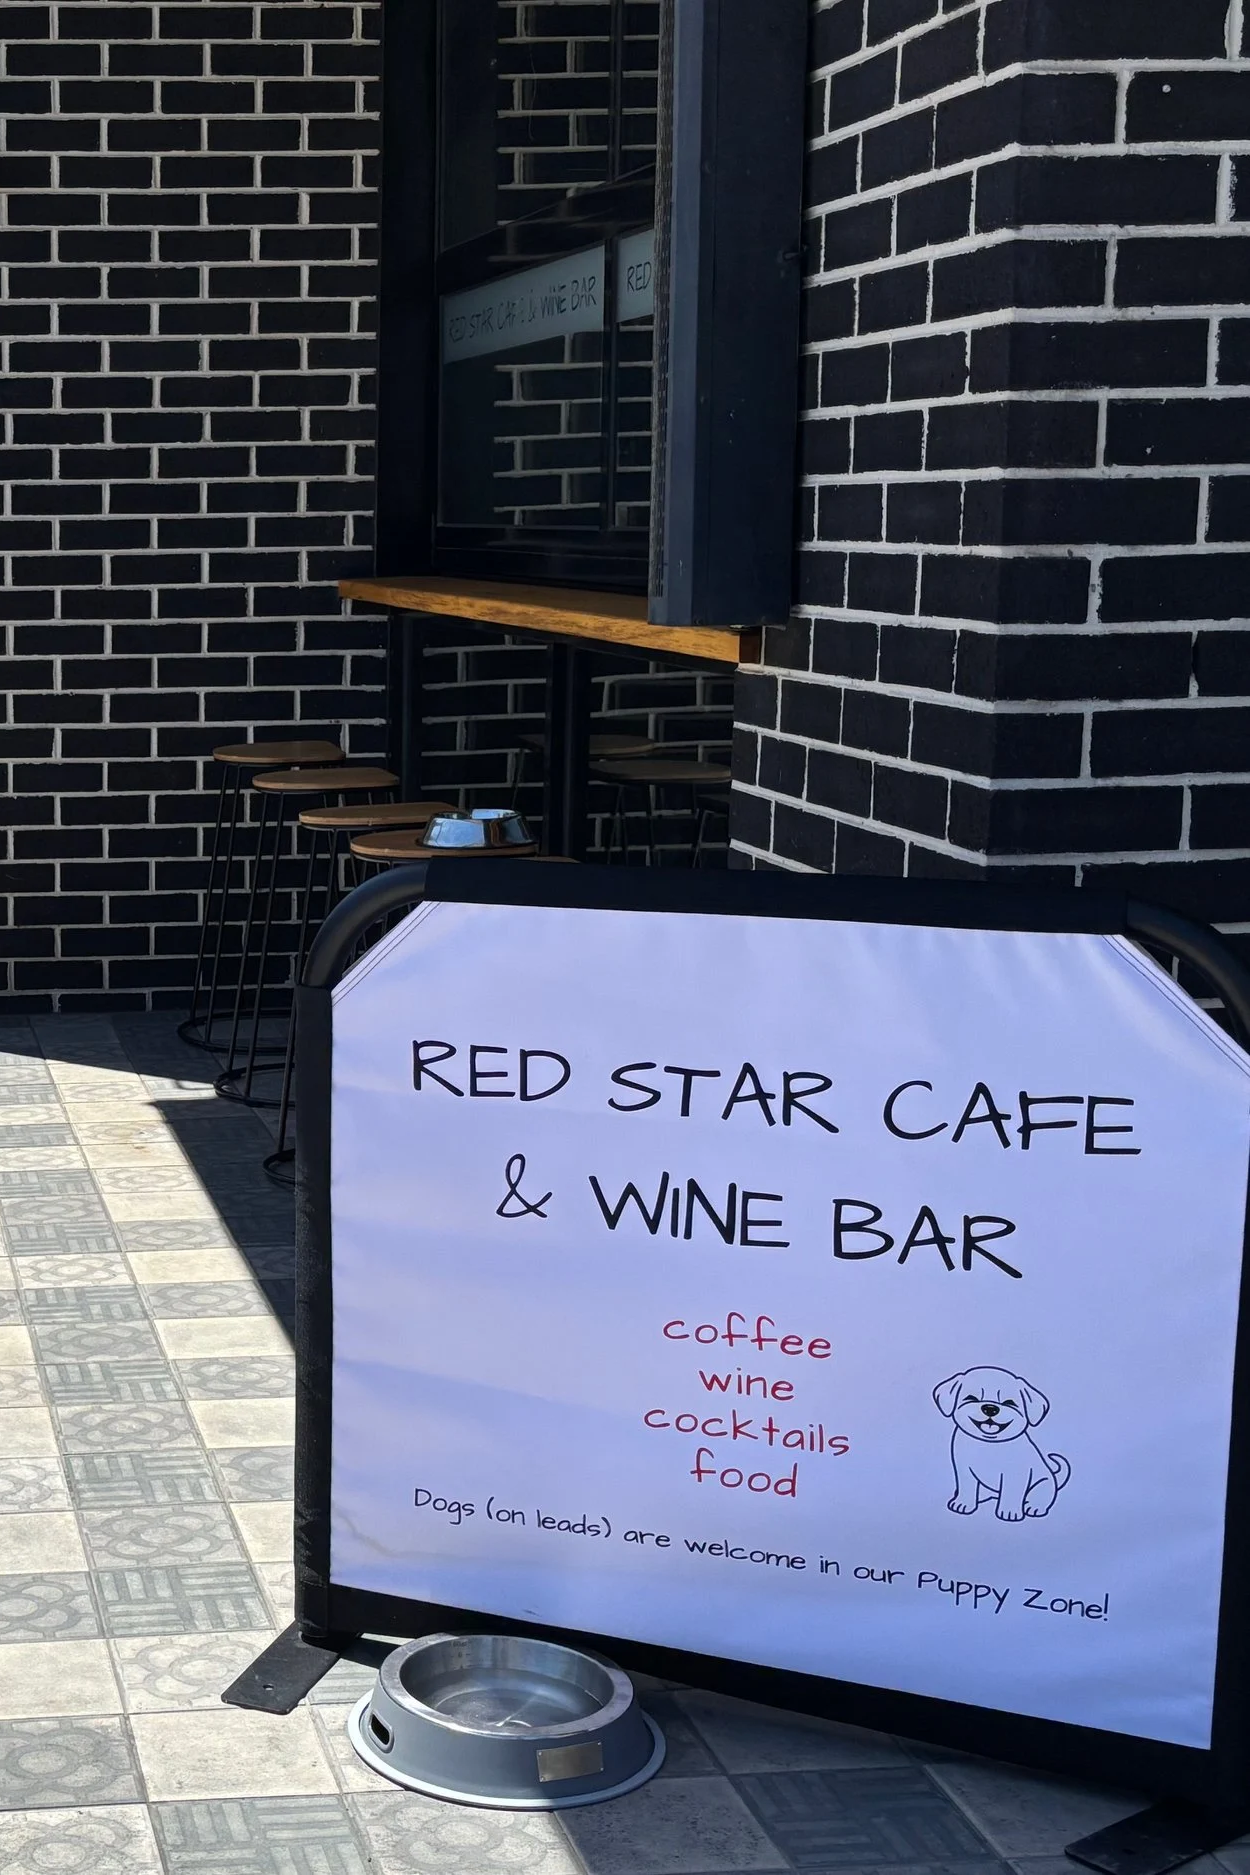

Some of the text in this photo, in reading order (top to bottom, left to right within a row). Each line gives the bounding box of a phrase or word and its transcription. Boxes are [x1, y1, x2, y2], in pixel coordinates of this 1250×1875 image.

[539, 284, 567, 319] WINE
[570, 275, 597, 312] BAR
[626, 261, 652, 293] RED
[412, 1039, 1142, 1156] RED STAR CAFE
[495, 1153, 1023, 1279] & WINE BAR
[662, 1311, 832, 1359] coffee
[698, 1366, 795, 1402] wine
[643, 1408, 850, 1457] cocktails
[689, 1447, 798, 1498] food
[413, 1487, 1110, 1622] Dogs (on leads) are welcome in our Puppy Zone!
